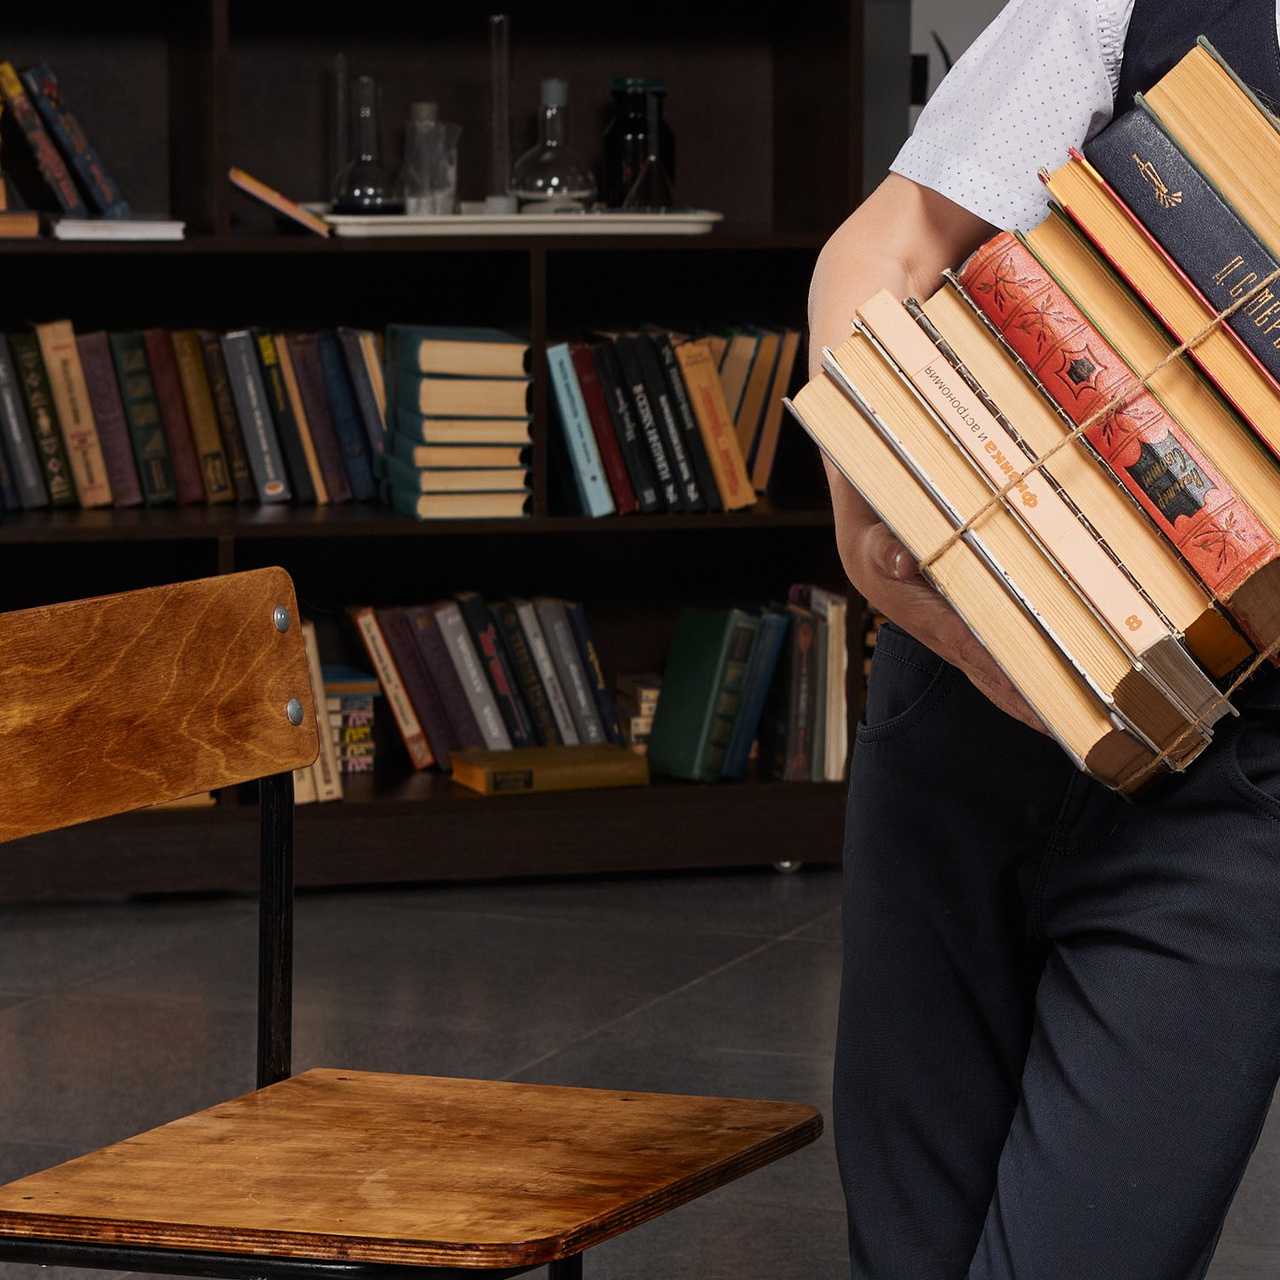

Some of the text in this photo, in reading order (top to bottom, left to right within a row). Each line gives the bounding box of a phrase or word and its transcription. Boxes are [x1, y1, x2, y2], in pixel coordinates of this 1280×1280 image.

[924, 365, 1039, 509] Физика и астрономия
